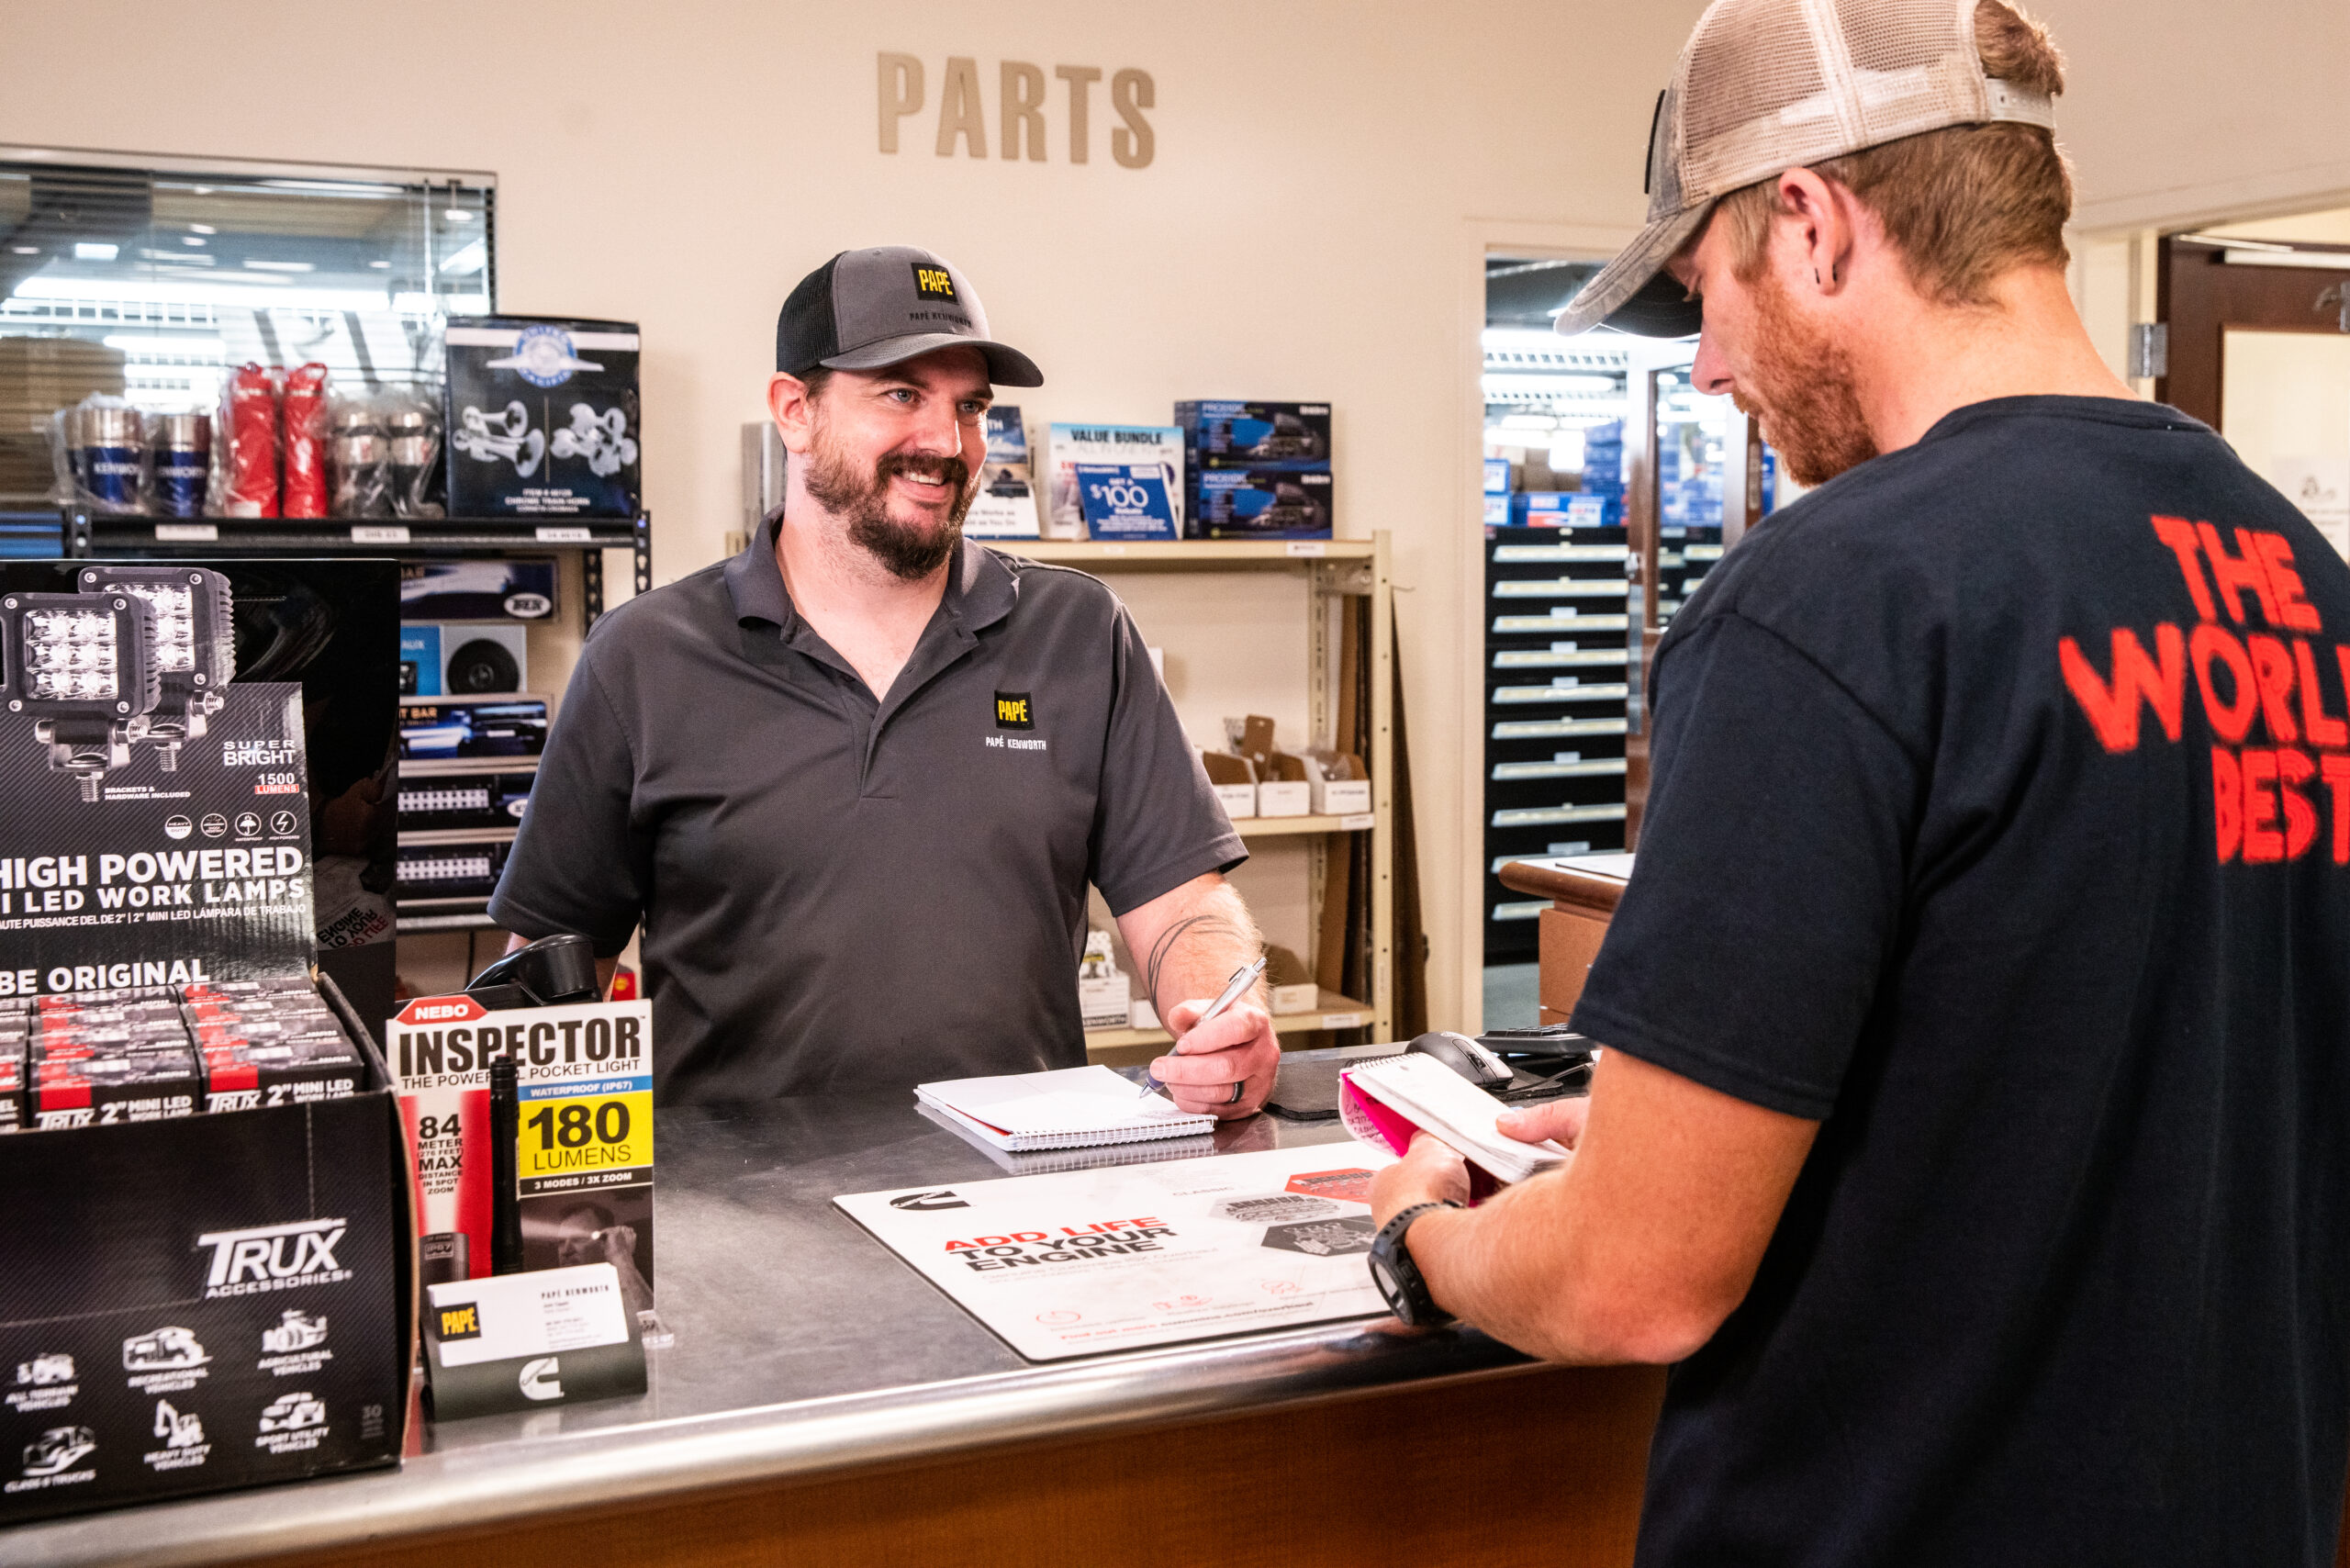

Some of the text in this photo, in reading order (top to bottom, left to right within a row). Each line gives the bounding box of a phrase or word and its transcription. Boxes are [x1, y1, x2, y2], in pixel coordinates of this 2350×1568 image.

[876, 50, 1158, 171] PARTS
[1070, 429, 1163, 445] VALUE BUNDLE
[2151, 514, 2322, 632] THE
[2058, 622, 2350, 754] WORL
[223, 740, 296, 750] SUPER
[1007, 738, 1046, 751] KENWORTH
[223, 749, 296, 766] BRIGHT
[256, 785, 297, 793] LUMENS
[258, 772, 296, 785] 1500
[105, 786, 148, 794] BRACKETS
[105, 792, 151, 801] HARDWARE
[99, 846, 304, 884] POWERED
[24, 890, 84, 913] LED
[96, 883, 194, 910] WORK
[205, 878, 306, 903] LAMPS
[22, 915, 80, 929] PUISSANCE
[100, 914, 115, 924] DE
[146, 911, 168, 922] MINI
[170, 910, 191, 921] LED
[193, 906, 241, 919] LÁMPARA
[243, 906, 257, 916] DE
[259, 903, 307, 915] TRABAJO
[48, 958, 210, 992] ORIGINAL
[415, 1004, 468, 1020] NEBO
[398, 1015, 641, 1078] INSPECTOR
[401, 1078, 433, 1091] THE
[530, 1063, 591, 1081] POCKET
[596, 1059, 641, 1073] LIGHT
[205, 1090, 262, 1114] TRUX
[292, 1081, 324, 1093] MINI
[326, 1078, 354, 1092] LED
[530, 1081, 633, 1098] WATERPROOF (IP67)
[128, 1099, 161, 1111] MINI
[162, 1095, 193, 1109] LED
[419, 1113, 463, 1139] 84
[527, 1101, 632, 1150] 180
[417, 1137, 464, 1150] METER
[439, 1148, 464, 1157] FEET)
[418, 1155, 464, 1171] MAX
[533, 1144, 632, 1170] LUMENS
[418, 1170, 464, 1181] DISTANCE
[435, 1177, 459, 1187] SPOT
[534, 1181, 543, 1191] 3
[543, 1177, 580, 1190] MODES
[587, 1175, 601, 1186] 3X
[601, 1171, 632, 1183] ZOOM
[427, 1186, 454, 1195] ZOOM
[945, 1216, 1169, 1252] ADD LIFE
[948, 1226, 1179, 1261] TO YOUR
[197, 1217, 348, 1287] TRUX
[966, 1239, 1165, 1271] ENGINE
[205, 1270, 348, 1299] ACCESSORIES
[254, 1426, 330, 1448] SPORT UTILITY
[143, 1450, 181, 1464] HEAVY
